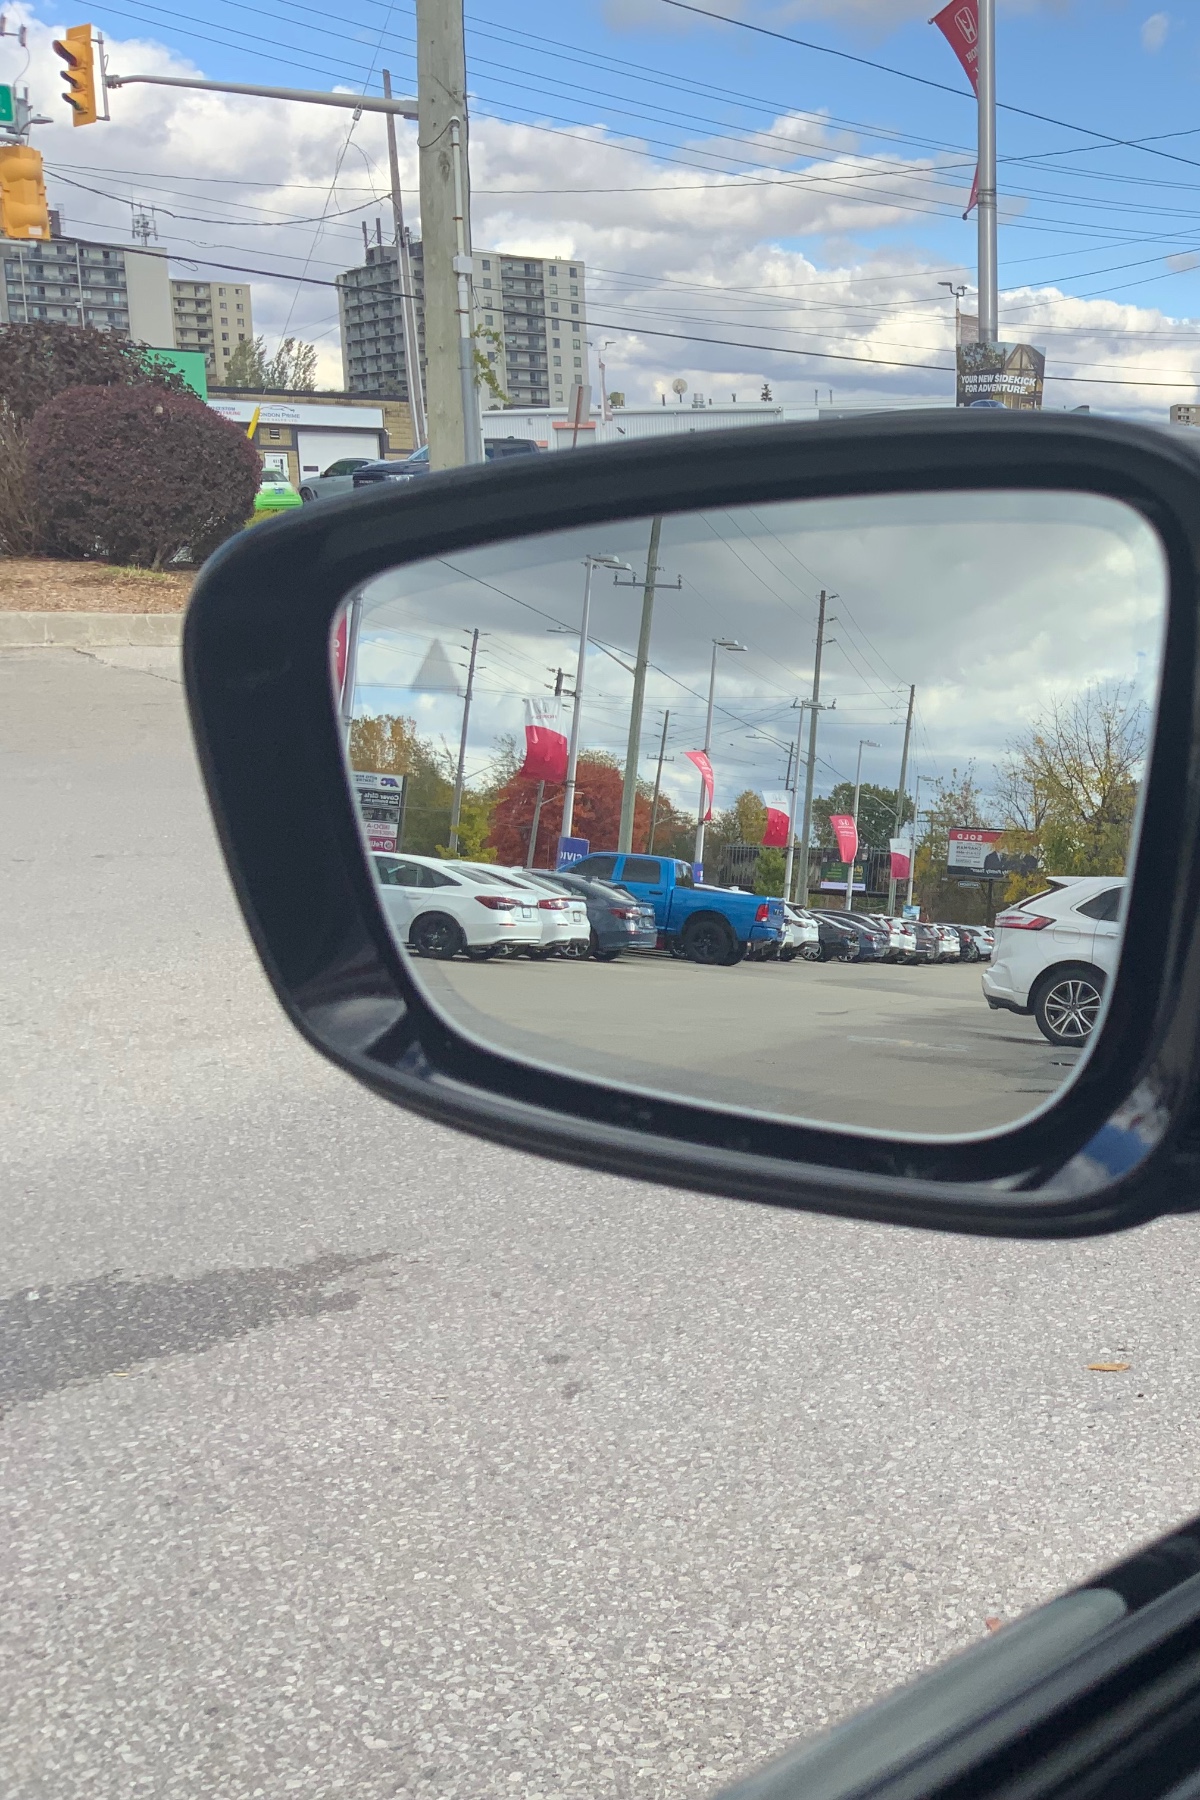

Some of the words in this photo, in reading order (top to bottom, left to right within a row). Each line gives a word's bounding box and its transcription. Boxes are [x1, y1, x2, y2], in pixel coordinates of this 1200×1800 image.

[961, 375, 978, 384] YOUR
[978, 374, 994, 383] NEW
[994, 374, 1036, 386] SIDEKICK
[965, 384, 978, 393] FOR
[978, 383, 1028, 395] ADVENTURE.
